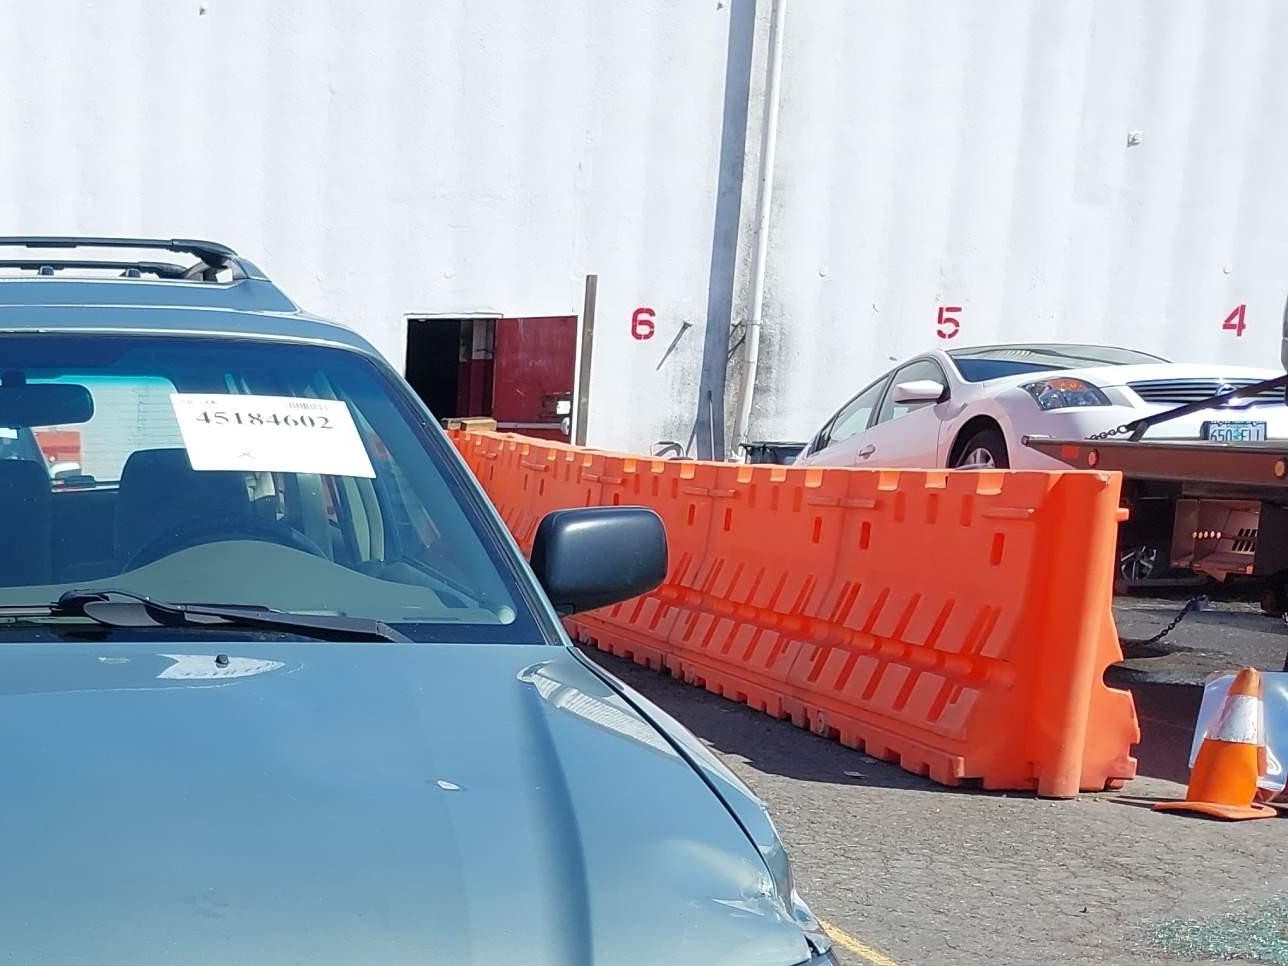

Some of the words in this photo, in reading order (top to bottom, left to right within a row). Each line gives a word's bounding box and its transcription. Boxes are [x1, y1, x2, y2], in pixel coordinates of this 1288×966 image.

[630, 307, 655, 341] 6
[936, 306, 961, 339] 5
[1223, 304, 1246, 336] 4
[196, 410, 334, 430] 45184602
